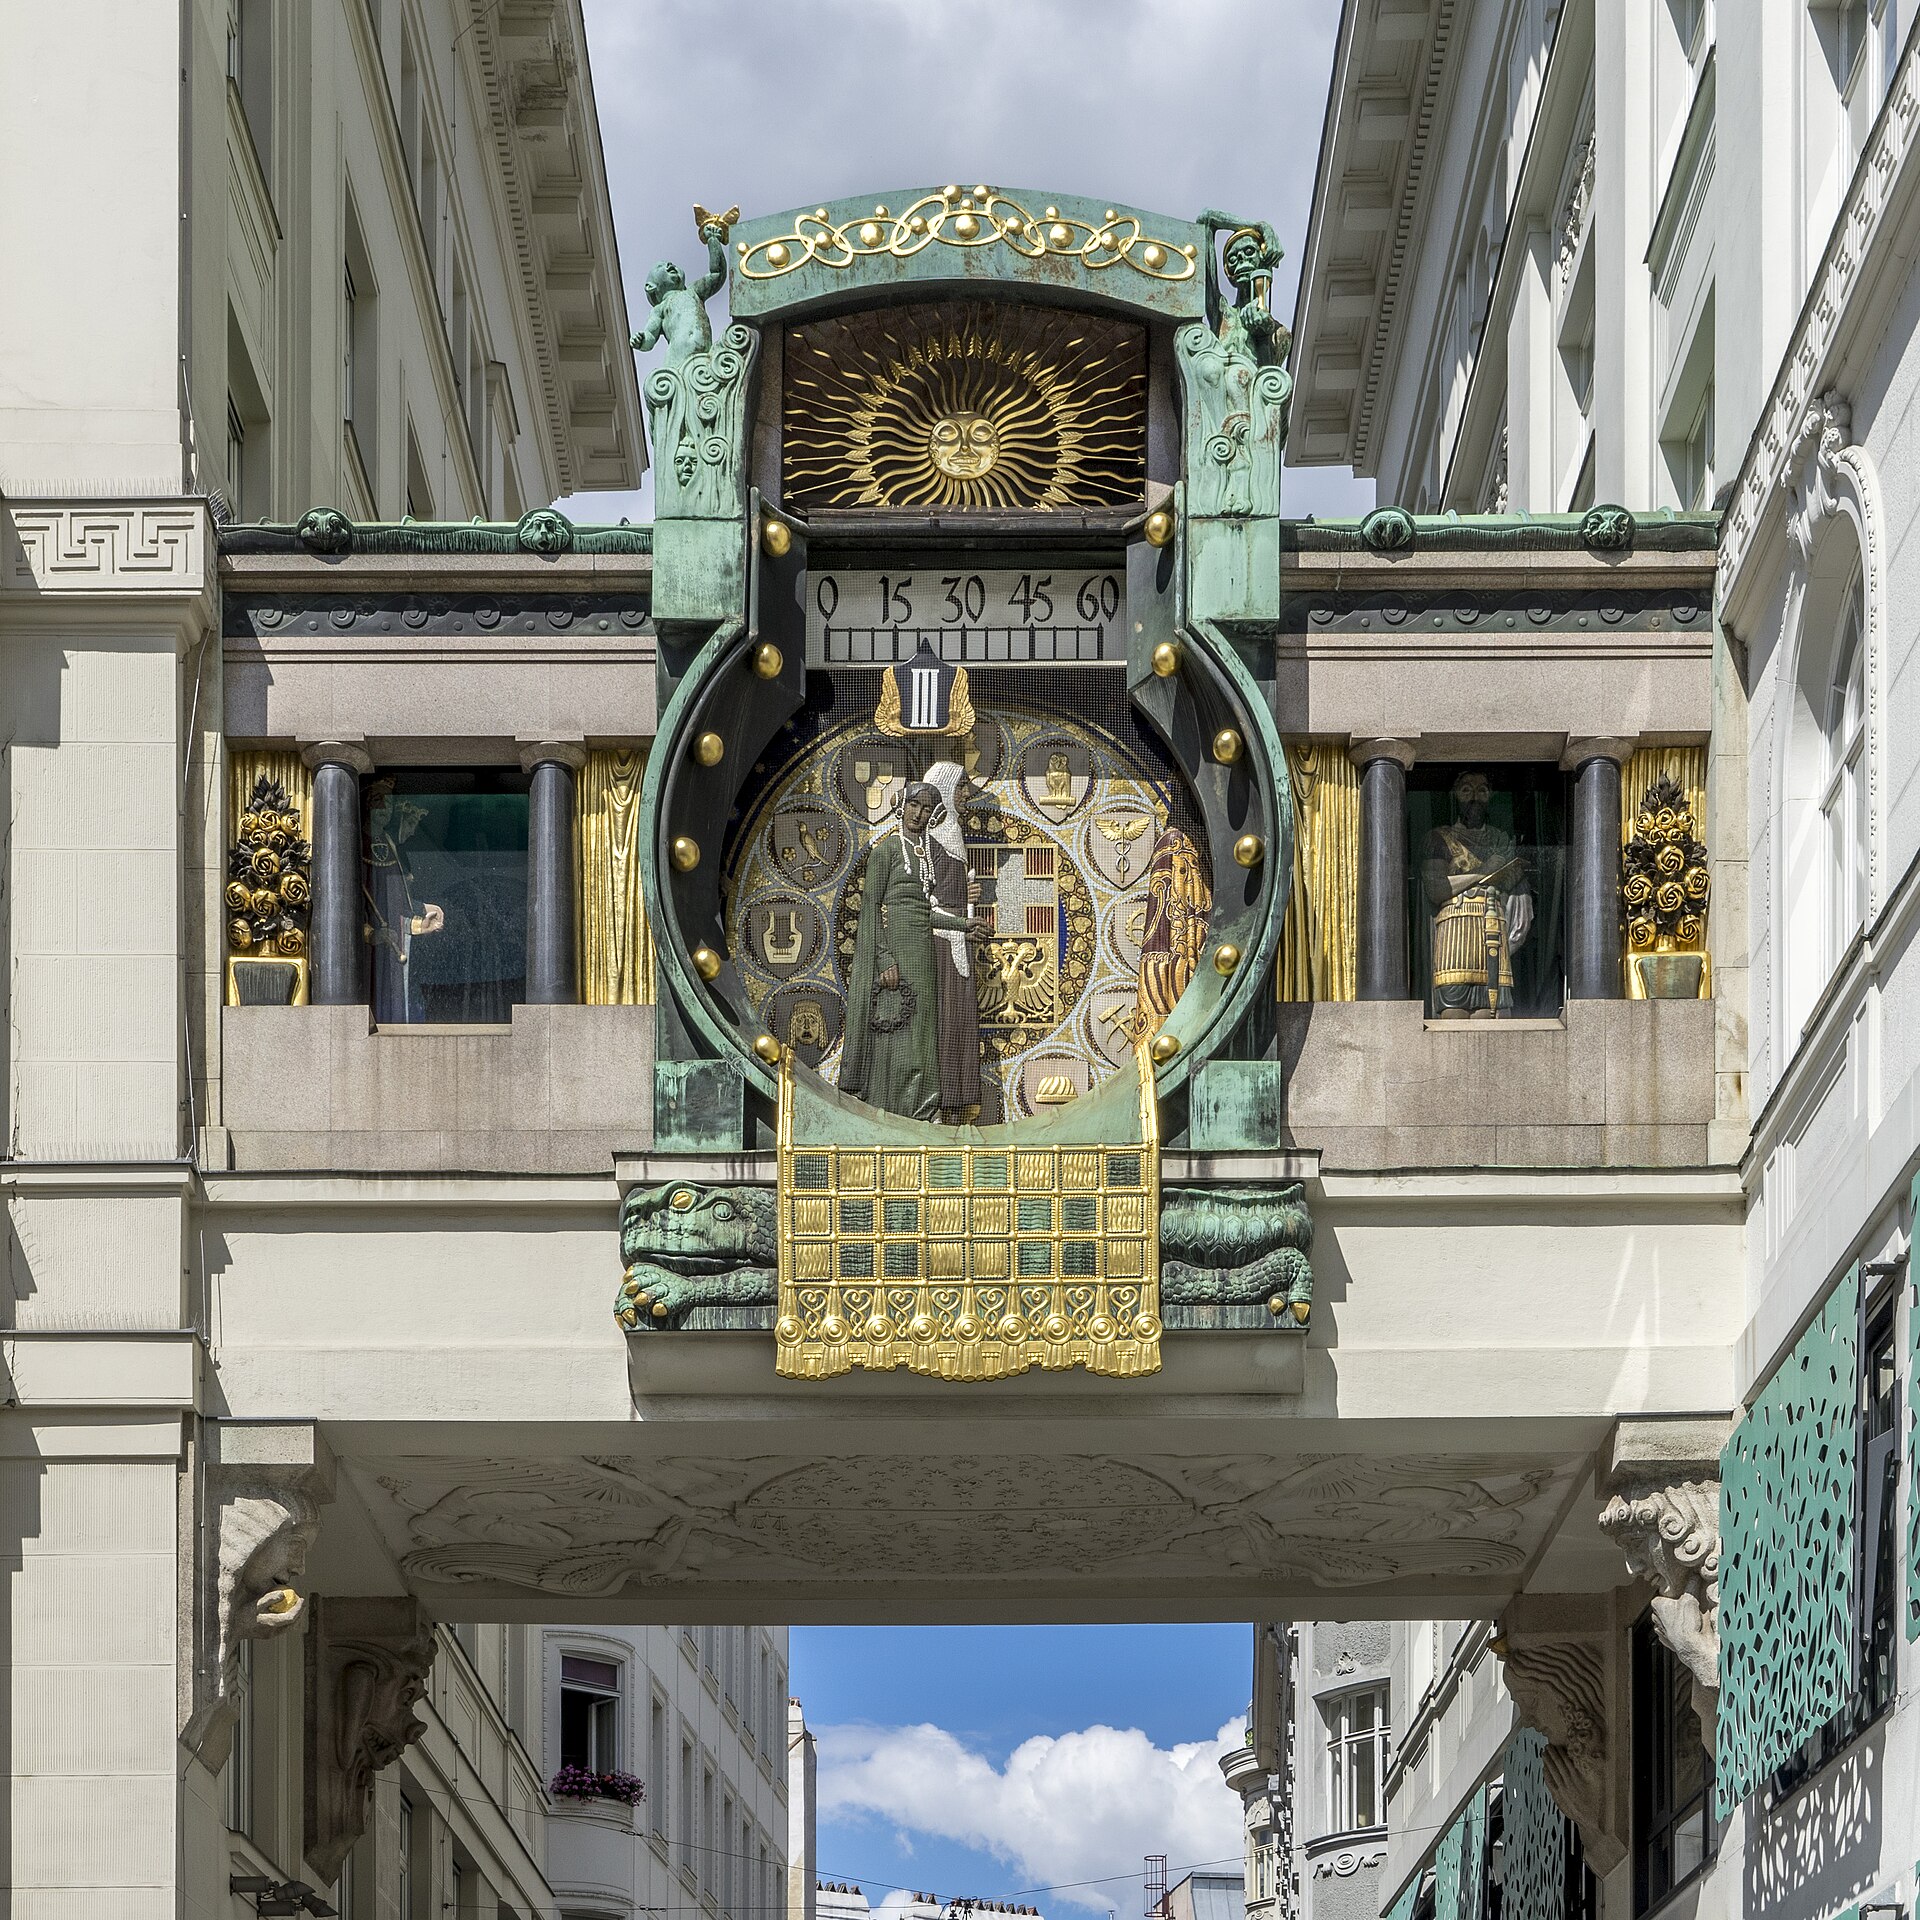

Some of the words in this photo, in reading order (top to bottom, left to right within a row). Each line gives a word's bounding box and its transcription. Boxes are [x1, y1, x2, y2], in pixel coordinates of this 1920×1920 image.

[817, 575, 839, 622] 0
[879, 575, 912, 624] 15
[940, 575, 986, 624] 30
[1007, 574, 1054, 625] 45
[1076, 575, 1120, 623] 60
[910, 668, 940, 728] III
